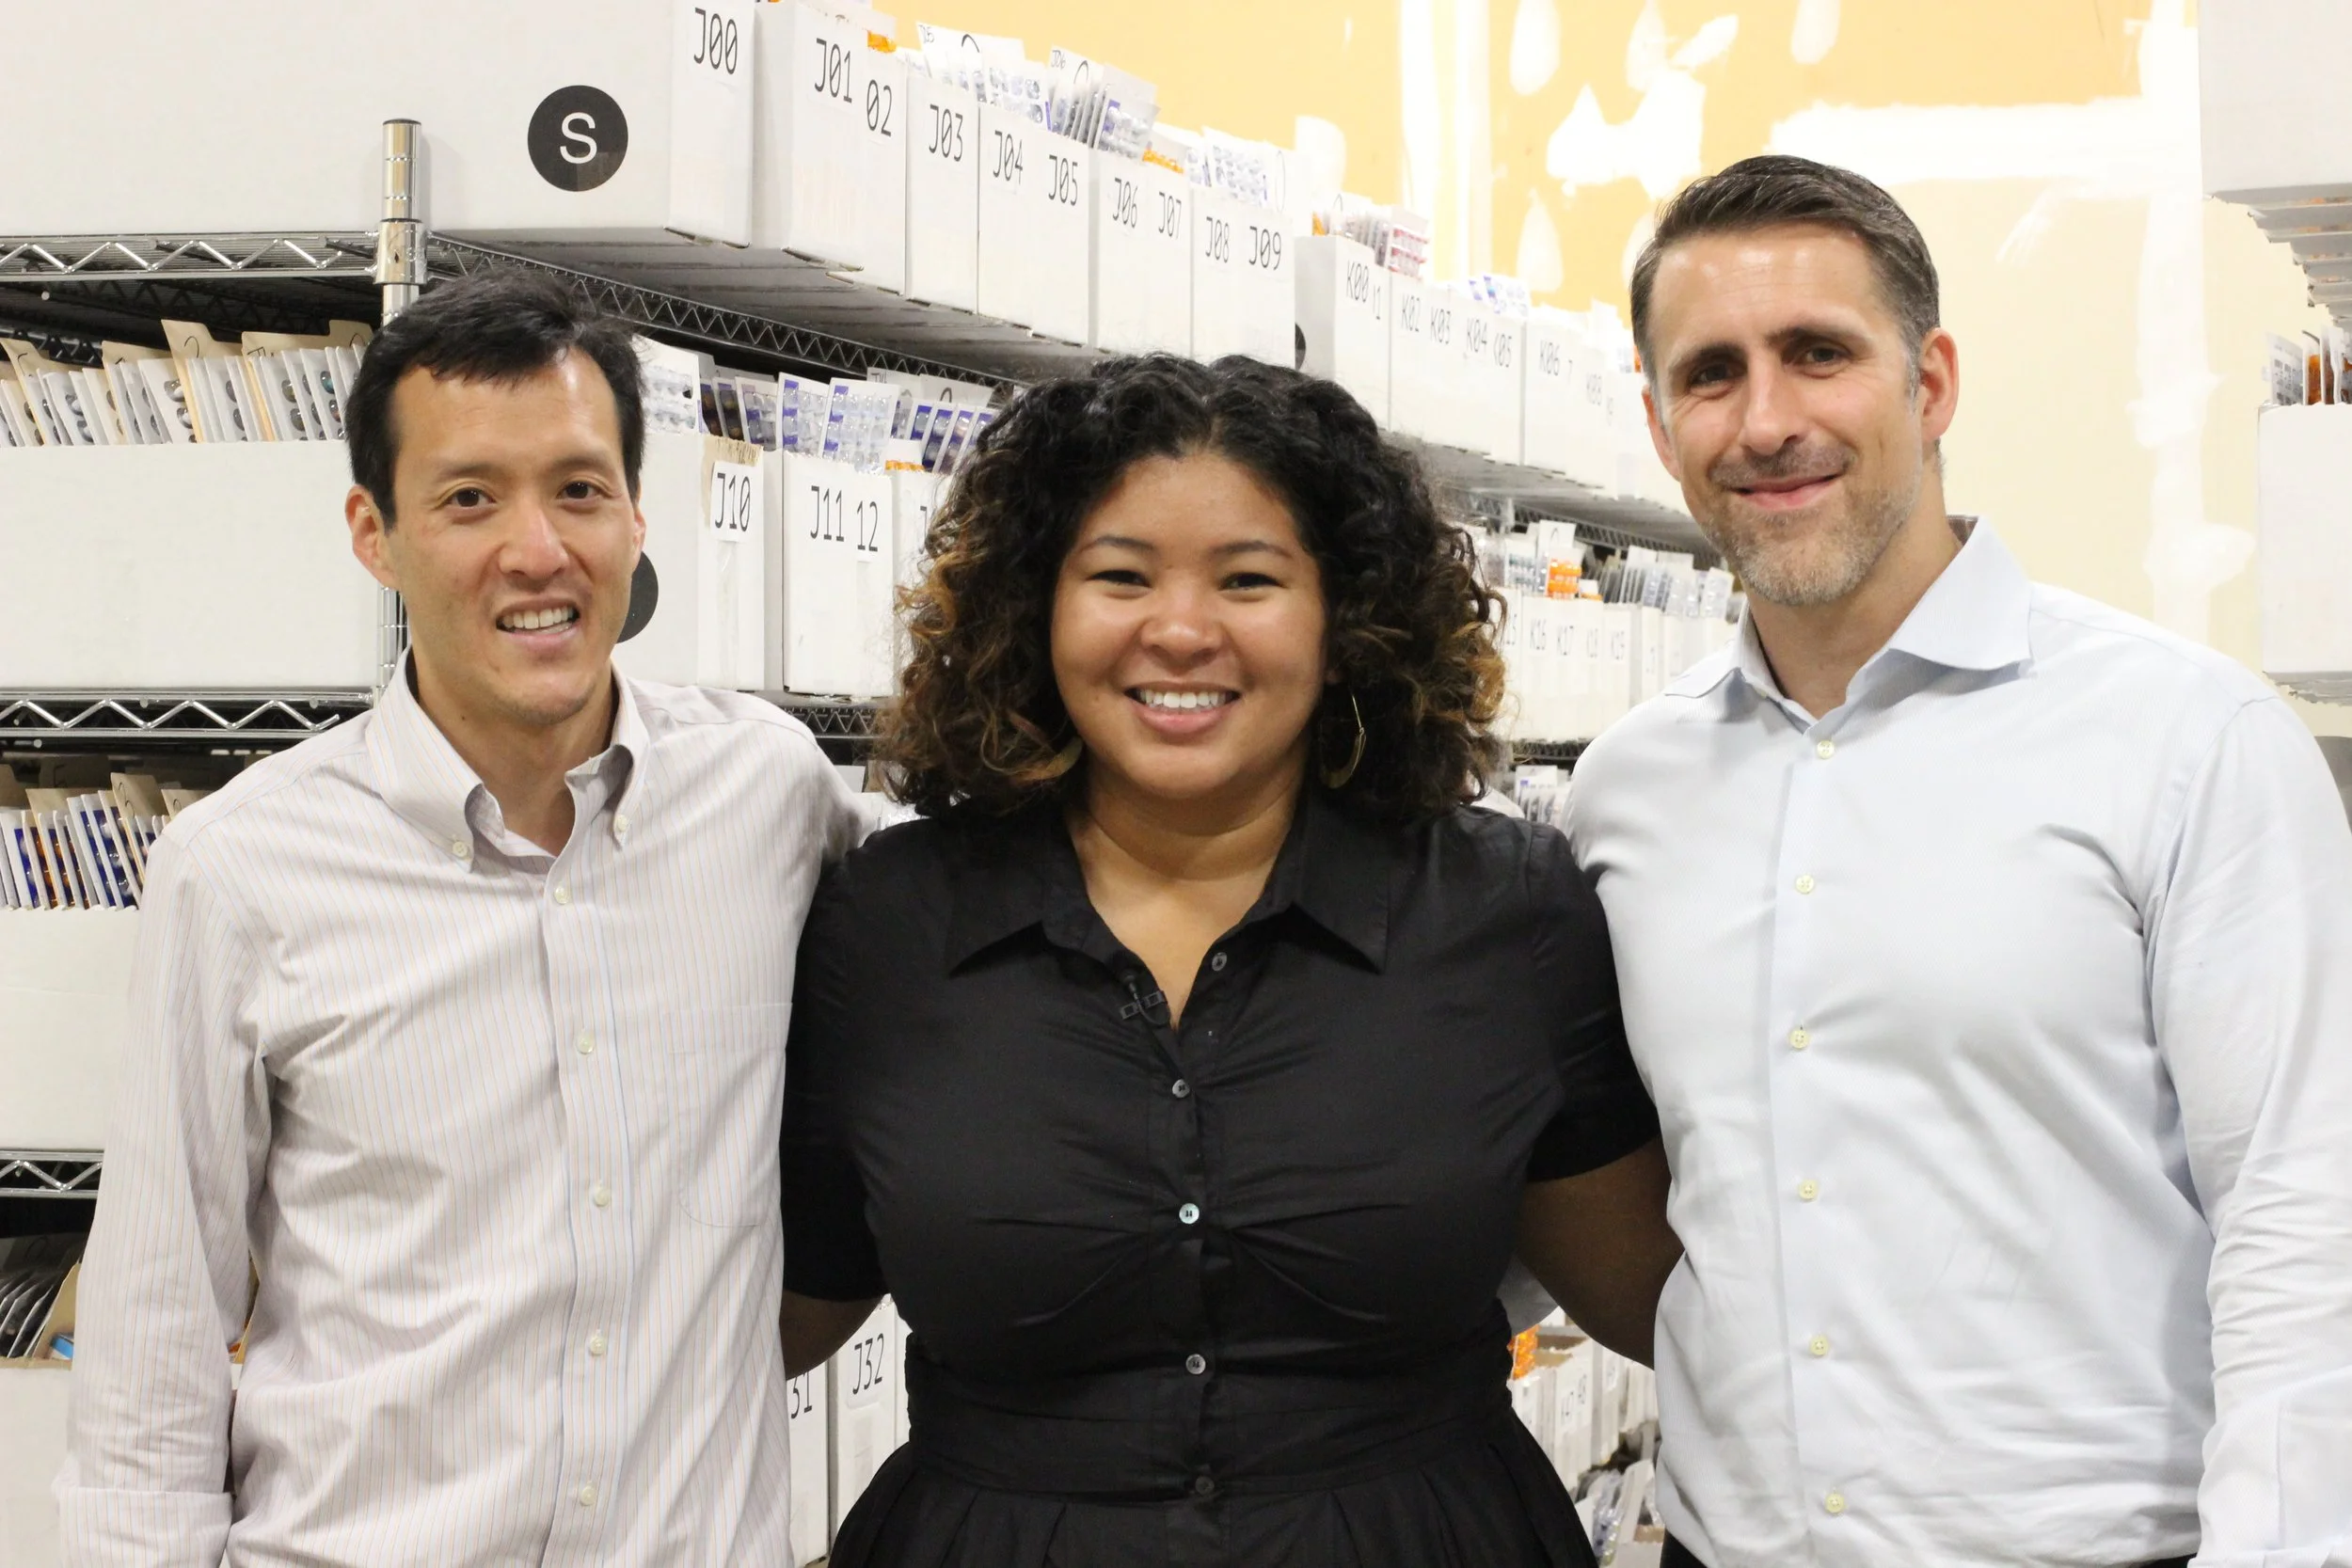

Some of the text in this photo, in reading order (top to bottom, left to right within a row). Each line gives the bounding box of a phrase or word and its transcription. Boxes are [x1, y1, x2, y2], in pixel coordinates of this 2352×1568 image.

[693, 8, 738, 75] J00
[815, 39, 853, 103] J01
[866, 79, 893, 137] 02
[929, 103, 963, 163] J03
[560, 112, 597, 165] S
[993, 130, 1024, 185] J04
[1048, 153, 1079, 207] J05
[1112, 177, 1138, 230] J06
[1158, 191, 1183, 242] J07
[1204, 215, 1231, 264] J08
[1248, 225, 1282, 271] J09
[1346, 260, 1369, 303] K00
[1401, 293, 1422, 333] K02
[1429, 306, 1452, 345] K03
[1466, 317, 1488, 354] K04
[1539, 340, 1561, 376] K06
[714, 471, 752, 533] J10
[809, 484, 845, 543] J11
[856, 500, 879, 553] 12
[852, 1333, 885, 1396] J32
